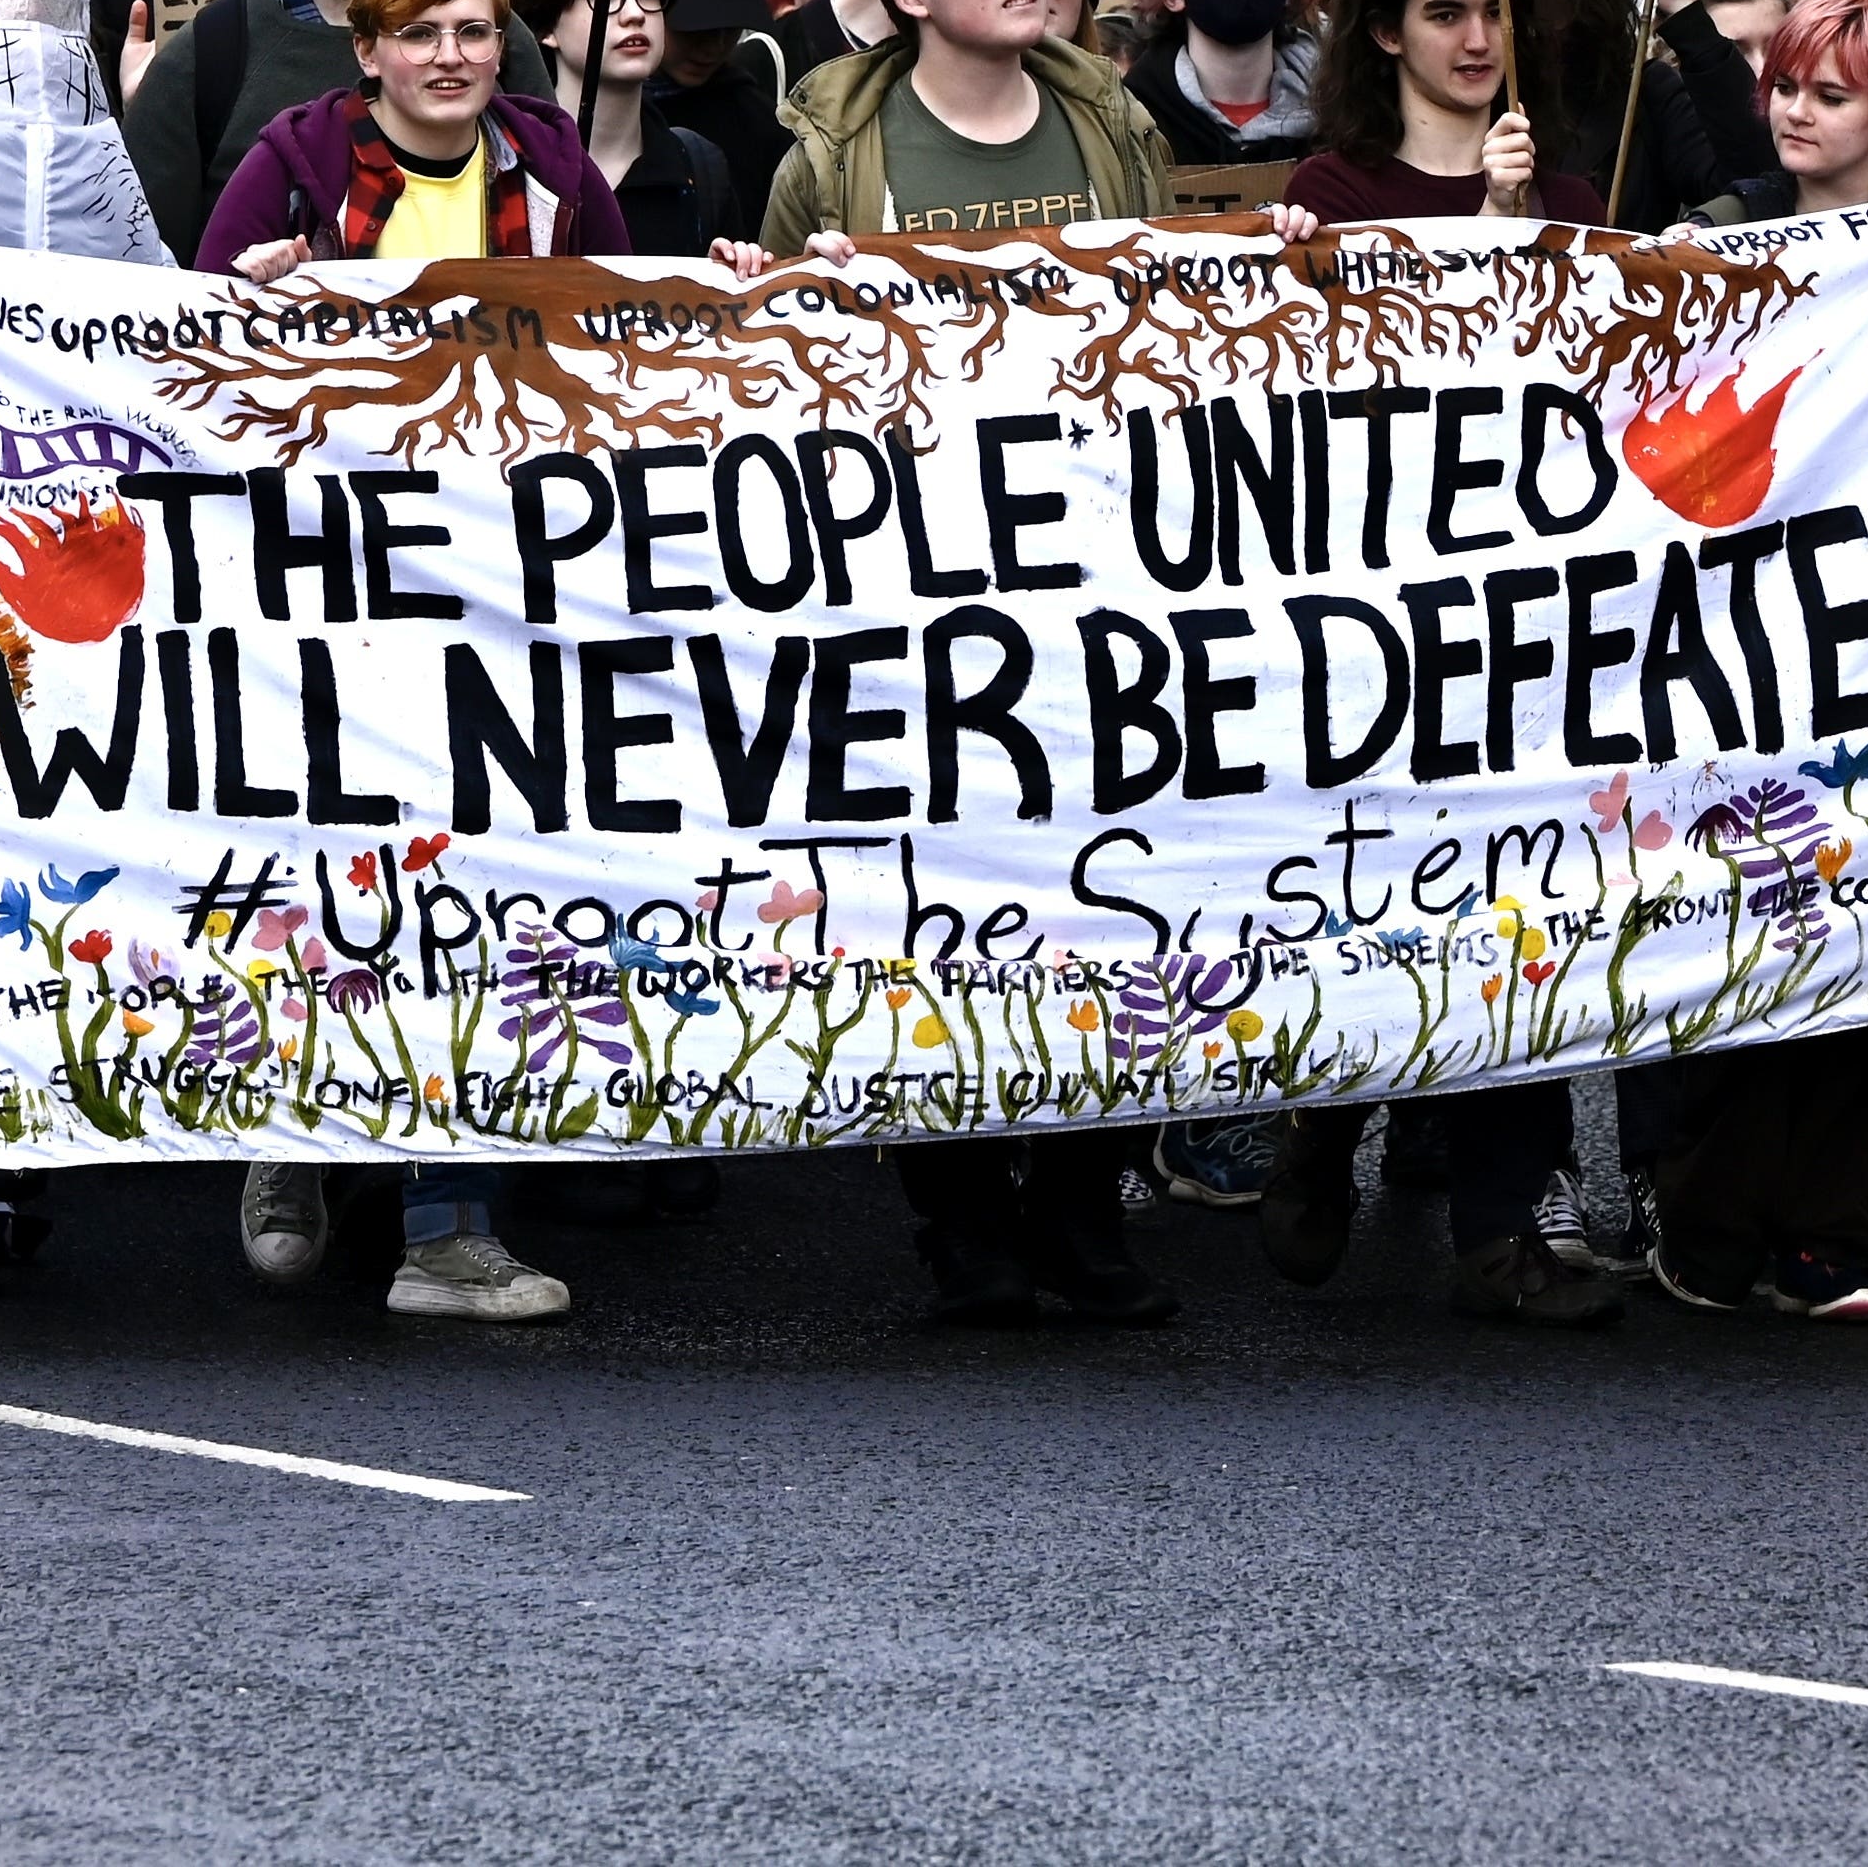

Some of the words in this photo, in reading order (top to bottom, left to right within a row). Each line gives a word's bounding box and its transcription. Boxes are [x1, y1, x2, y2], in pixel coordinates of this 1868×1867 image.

[50, 308, 226, 363] UPROOT
[245, 300, 544, 350] CAPITALISM
[583, 298, 749, 344] UPROOT
[763, 263, 1076, 320] COLONIALISM
[1114, 254, 1280, 307] UPROOT
[1307, 249, 1430, 292] WHITE
[1698, 219, 1828, 258] UPROOT
[16, 405, 55, 426] THE
[64, 405, 114, 424] RAIL
[116, 468, 464, 623] THE
[1128, 383, 1618, 590] UNITED
[444, 604, 1051, 835] NEVER
[1076, 606, 1266, 815] BE
[536, 959, 623, 999] THE
[637, 958, 833, 1000] WORKERS
[846, 958, 915, 994] THE
[941, 952, 1133, 996] FARMERS
[1229, 944, 1309, 981] THE
[1544, 909, 1608, 947] THE
[315, 1076, 413, 1111] ONE
[605, 1069, 772, 1110] GLOBAL
